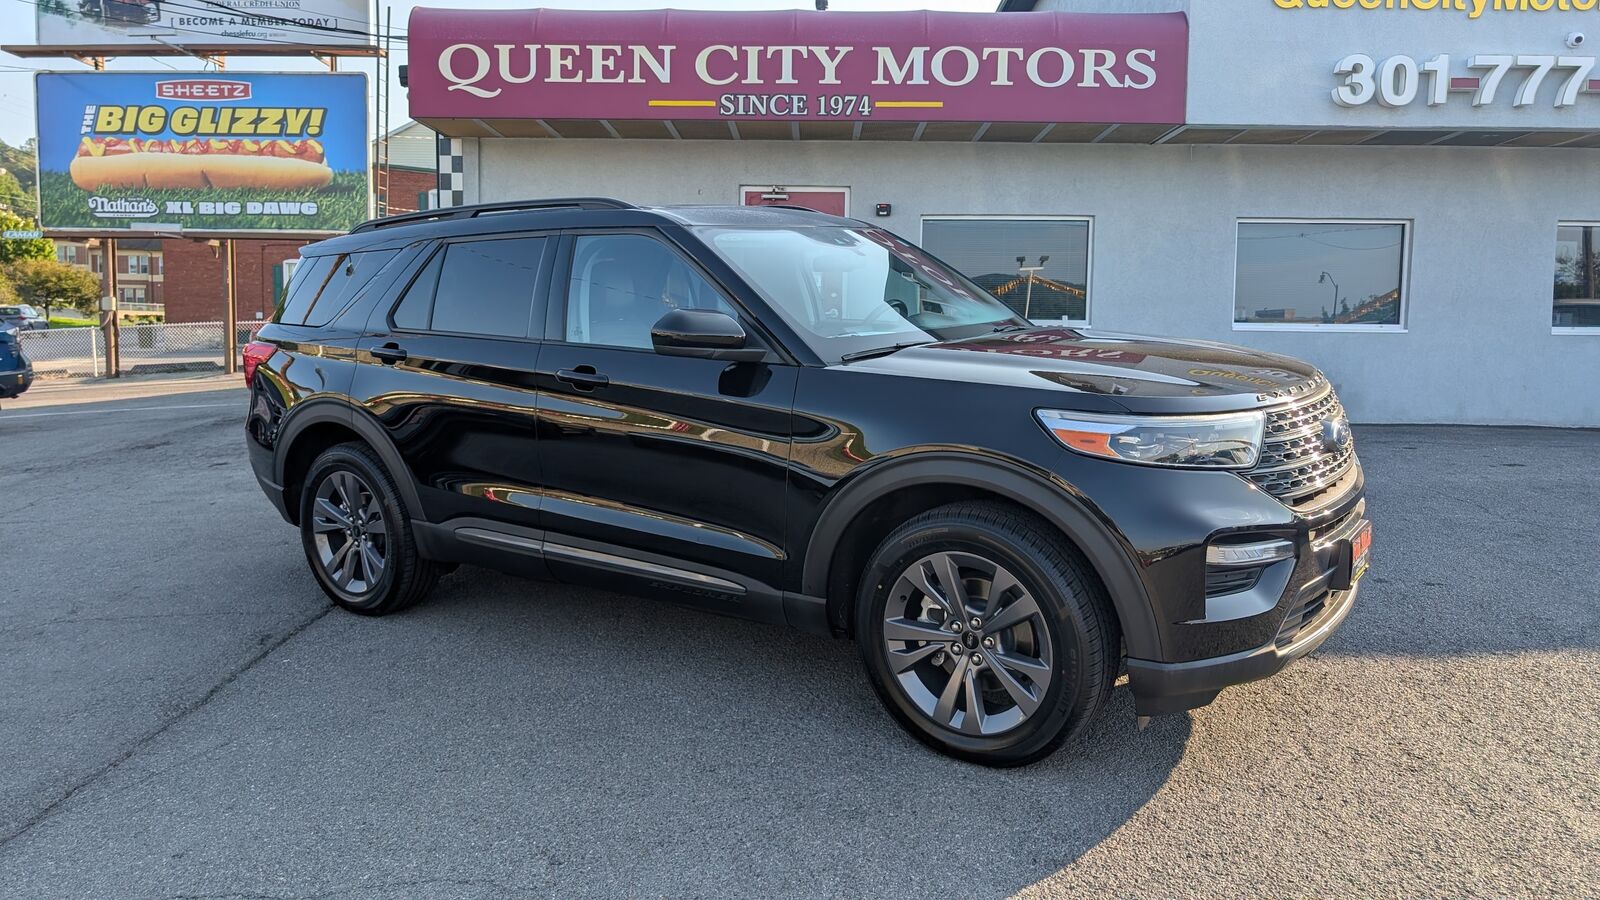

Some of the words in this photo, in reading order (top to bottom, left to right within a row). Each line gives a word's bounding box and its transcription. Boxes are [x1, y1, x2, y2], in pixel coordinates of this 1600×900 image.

[275, 0, 300, 8] UNION
[179, 17, 224, 26] BECOME
[229, 17, 237, 26] A
[241, 17, 288, 27] MEMBER
[292, 17, 330, 27] TODAY
[438, 43, 676, 99] QUEEN
[694, 44, 853, 85] CITY
[871, 45, 1157, 90] MOTORS
[161, 84, 246, 97] SHEETZ
[719, 94, 808, 116] SINCE
[816, 95, 872, 117] 1974
[81, 105, 97, 135] THE
[94, 104, 167, 135] BIG
[169, 105, 326, 136] GLIZZY!
[165, 201, 194, 214] XL
[198, 201, 242, 215] BIG
[246, 201, 318, 215] DAWG
